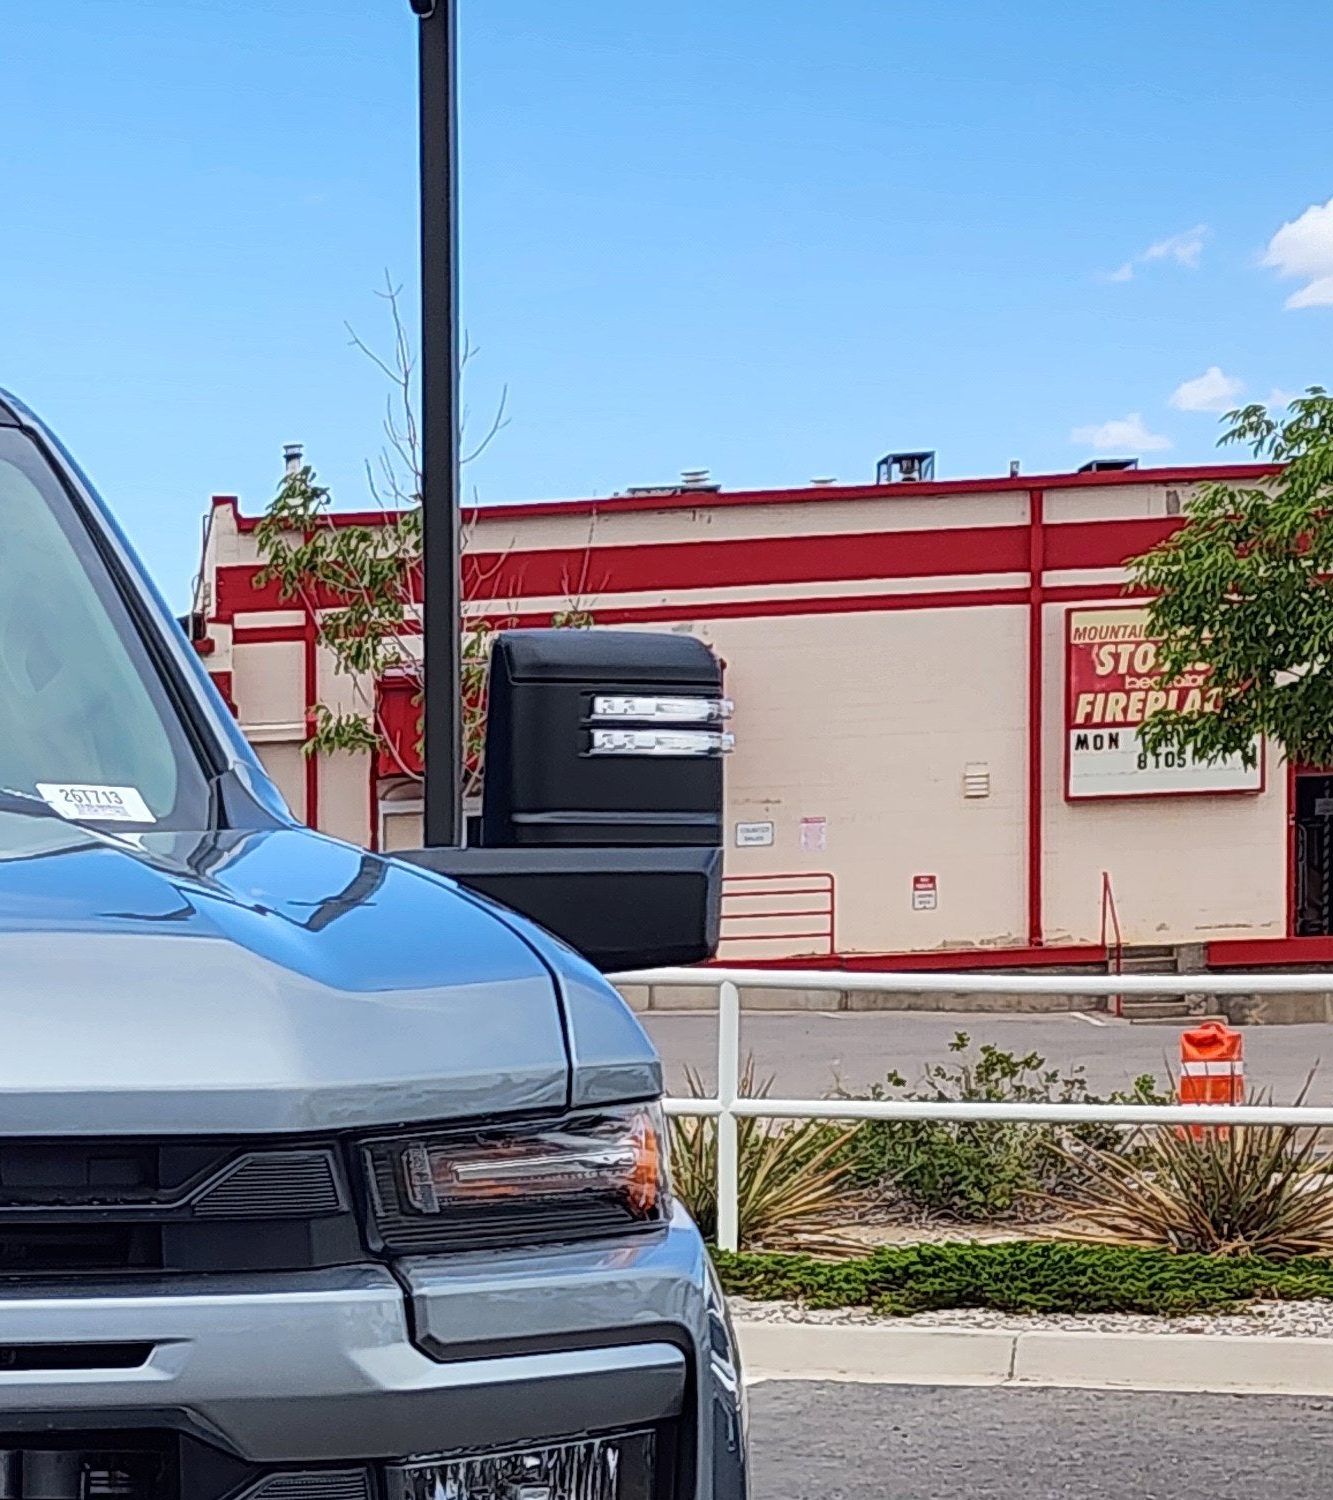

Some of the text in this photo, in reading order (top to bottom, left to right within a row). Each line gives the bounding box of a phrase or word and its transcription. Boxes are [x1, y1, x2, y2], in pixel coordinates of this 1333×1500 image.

[1073, 624, 1152, 641] MOUNTAI
[1074, 732, 1120, 751] MON
[58, 788, 124, 805] 267713
